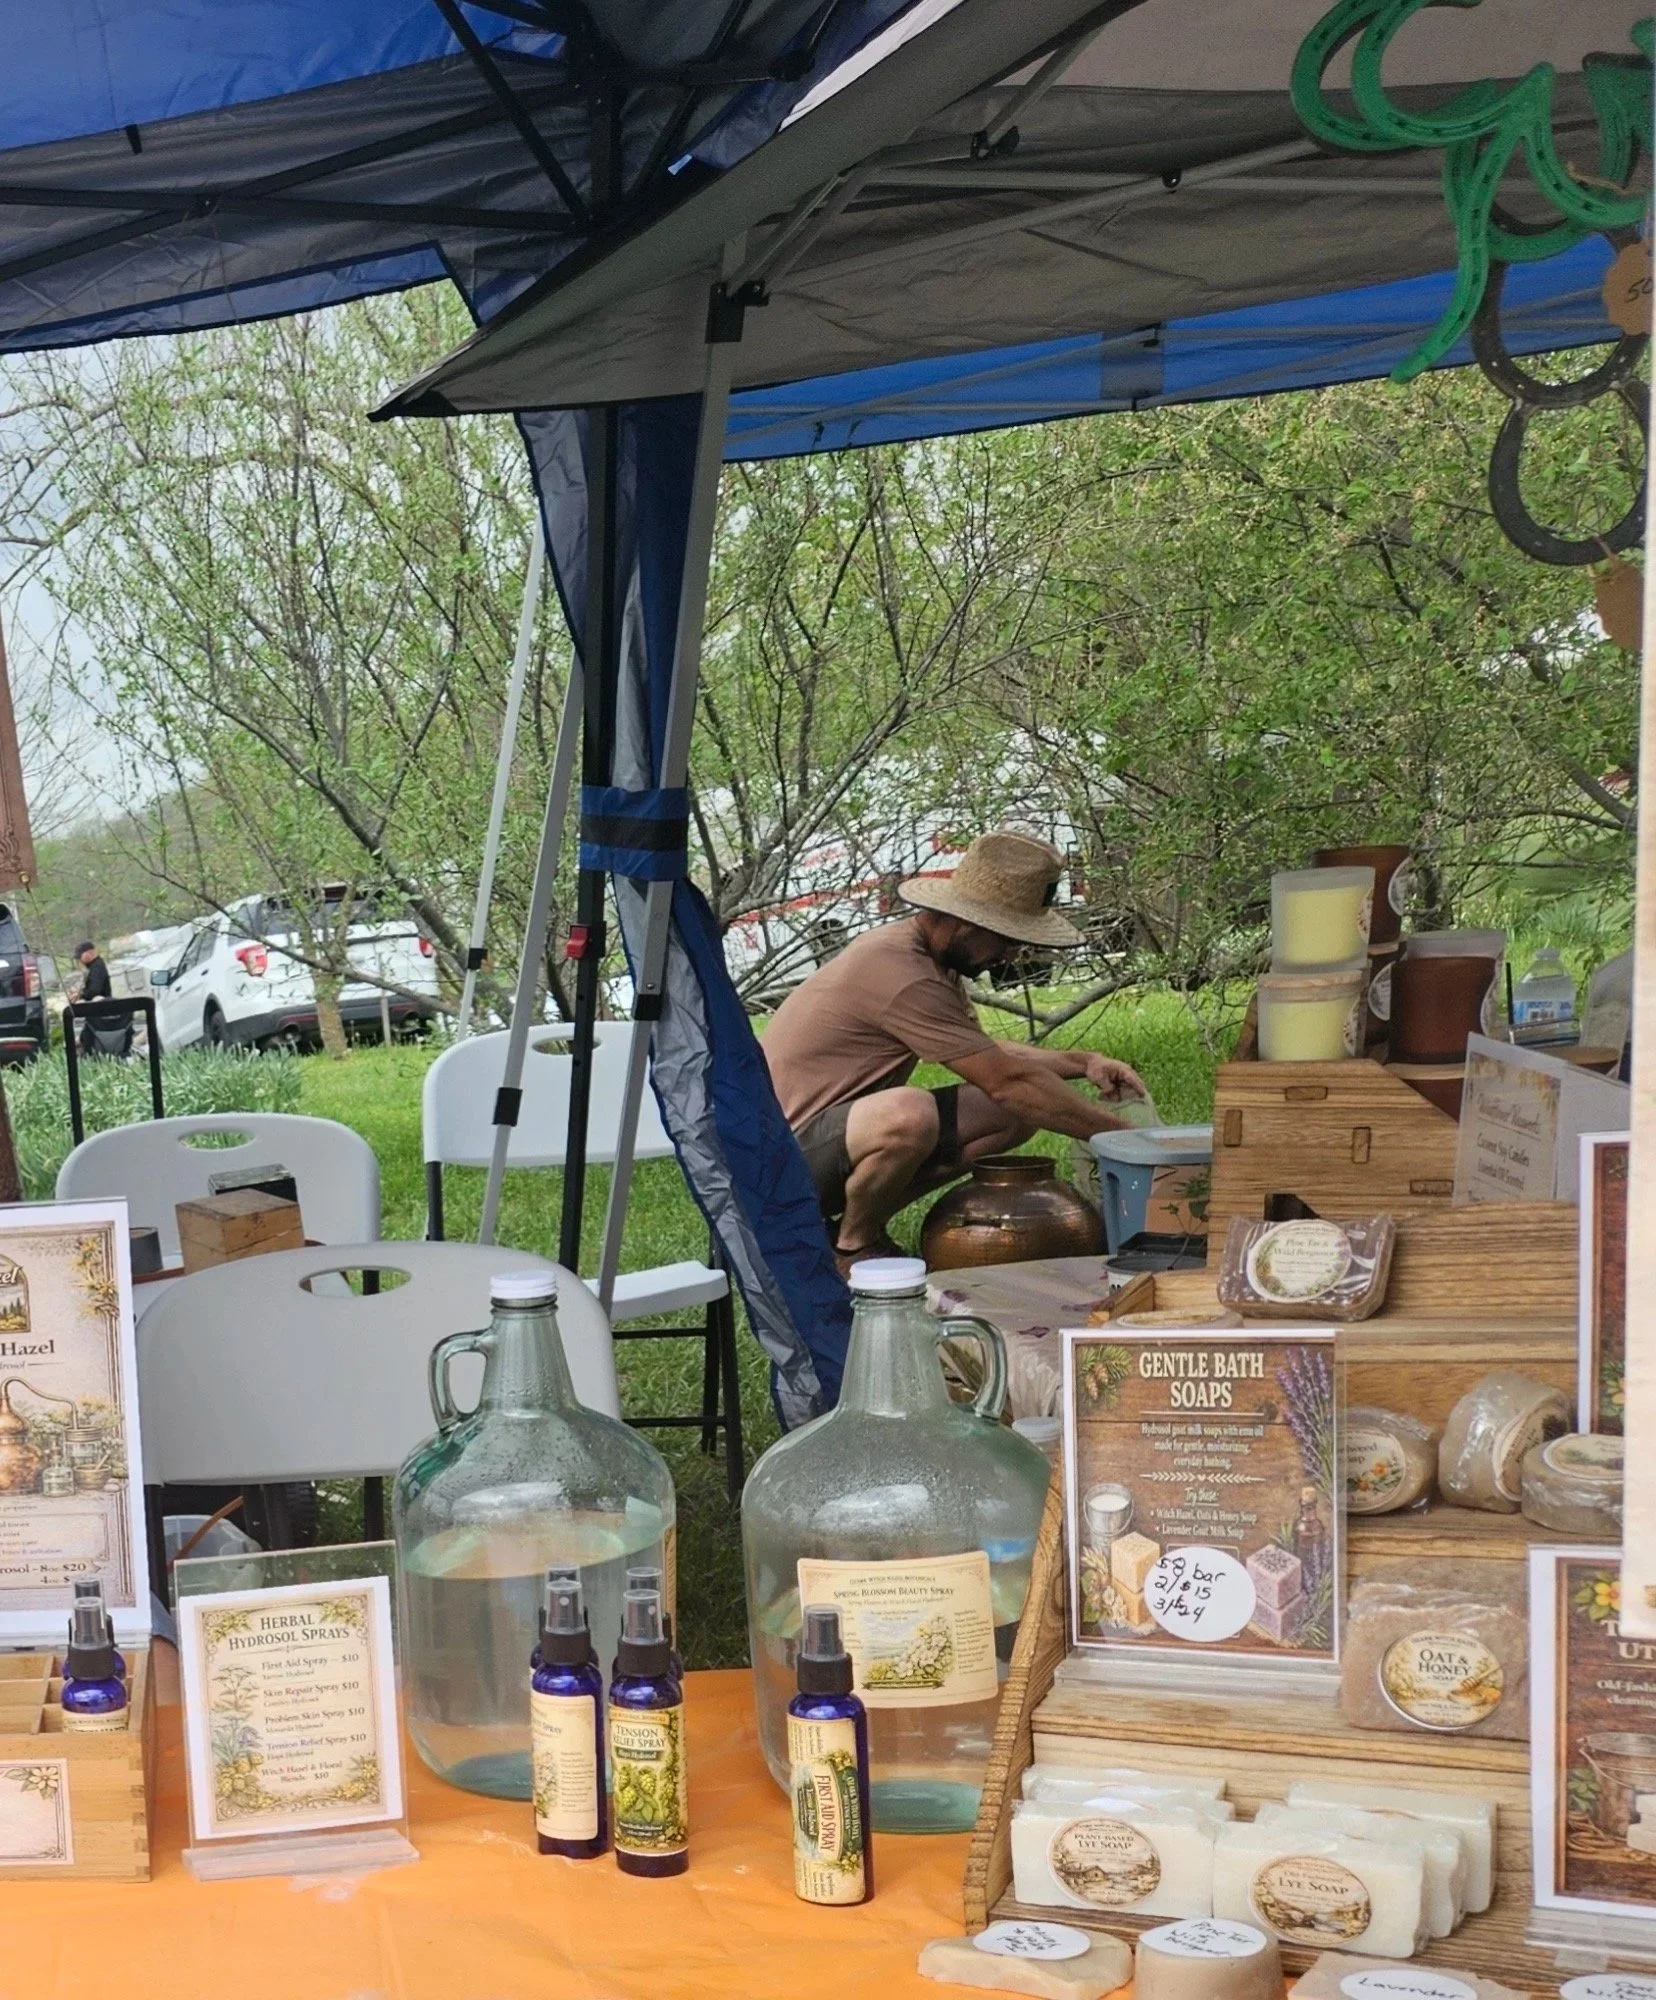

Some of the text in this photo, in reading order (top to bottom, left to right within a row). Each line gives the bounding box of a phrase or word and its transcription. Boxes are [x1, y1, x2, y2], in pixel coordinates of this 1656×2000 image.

[1, 1339, 55, 1357] Hazel
[1139, 1351, 1265, 1379] GENTLE BATH
[1170, 1380, 1233, 1409] SOAPS
[1203, 1426, 1223, 1439] soaps
[63, 1562, 87, 1573] $20
[1193, 1563, 1227, 1583] bar
[861, 1587, 897, 1598] BLOSSOM
[898, 1586, 928, 1596] BEAUTY
[930, 1586, 955, 1596] SPRAY
[260, 1613, 316, 1631] HERBAL
[228, 1627, 350, 1651] HYDROSOL SPRAYS
[261, 1653, 360, 1671] First Aid Spray $10
[1419, 1648, 1469, 1665] OAT &
[1417, 1660, 1473, 1677] HONEY
[263, 1681, 360, 1697] Skin Repair Spray $10
[264, 1706, 366, 1725] Problem Skin Spray $10
[615, 1723, 659, 1739] TENSION
[266, 1732, 367, 1752] Tension Relief Spray $10
[637, 1737, 666, 1749] SPRAY
[814, 1774, 838, 1853] FIRST AID SPRAY
[1078, 1840, 1133, 1850] LYE SOAP
[1278, 1876, 1350, 1895] LYE SOAP
[1358, 1978, 1466, 1999] Lavender
